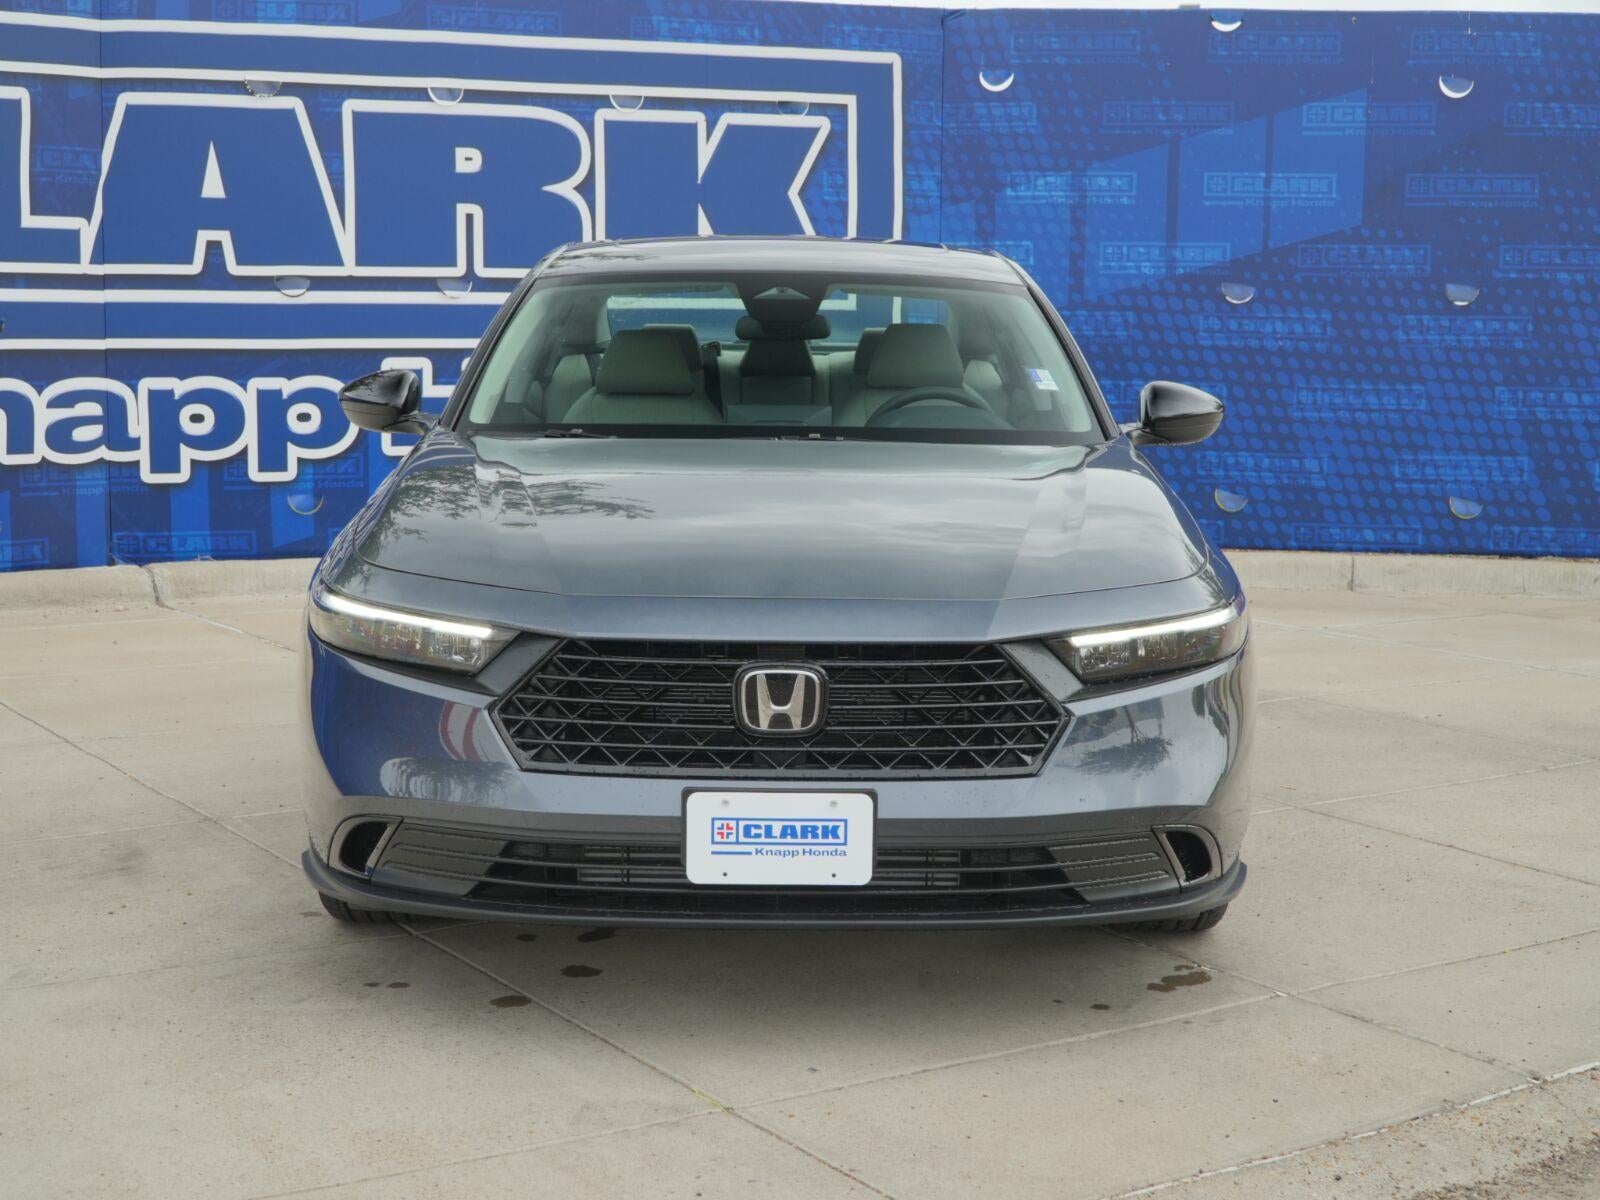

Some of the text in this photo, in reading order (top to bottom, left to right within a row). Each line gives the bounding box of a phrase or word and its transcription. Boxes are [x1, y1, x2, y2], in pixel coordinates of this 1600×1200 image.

[1233, 176, 1331, 193] CLARK
[742, 823, 841, 840] CLARK
[754, 847, 847, 857] Knapp Honda
